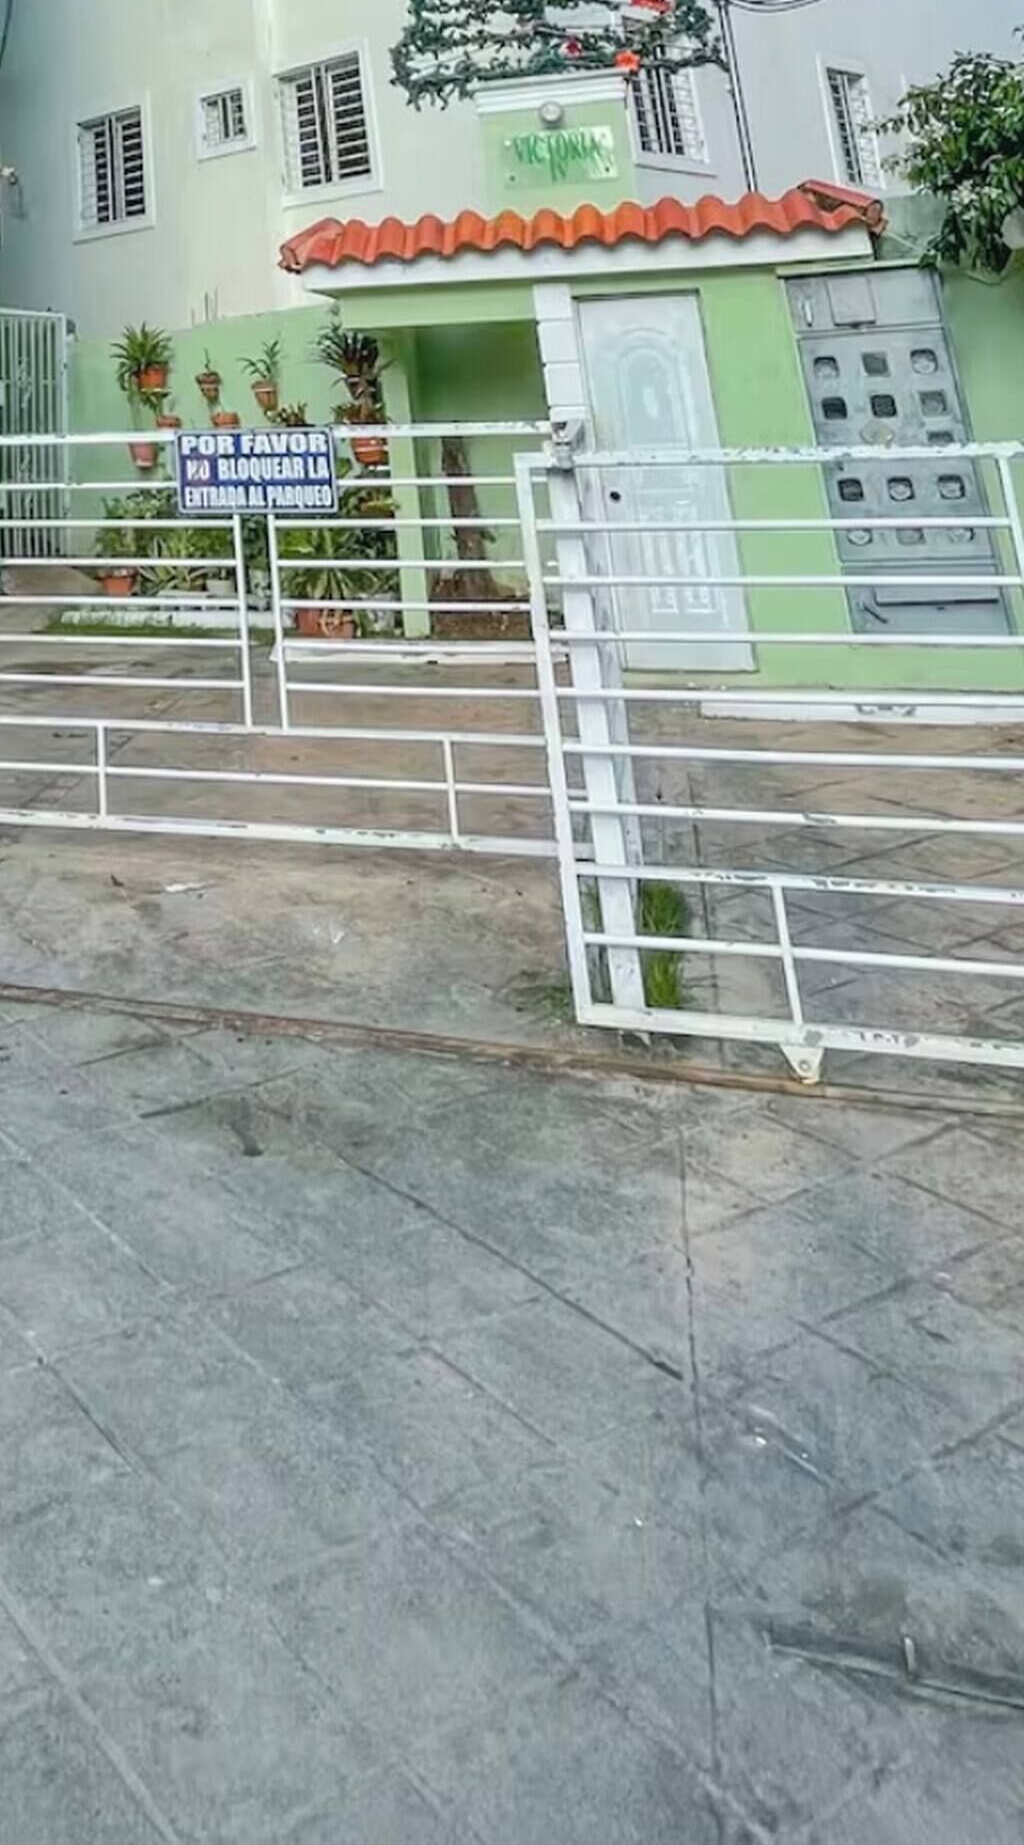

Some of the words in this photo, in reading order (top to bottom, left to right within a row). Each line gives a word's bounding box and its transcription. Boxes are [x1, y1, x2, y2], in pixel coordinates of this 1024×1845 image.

[513, 130, 603, 164] VICTORIA
[181, 436, 235, 455] POR
[239, 433, 329, 454] FAVOR
[186, 459, 211, 481] NO
[217, 456, 305, 482] BLOQUEAR
[307, 456, 329, 479] LA
[185, 485, 247, 508] ENTRADA
[248, 485, 266, 507] AL
[267, 485, 332, 508] PARQUEO
